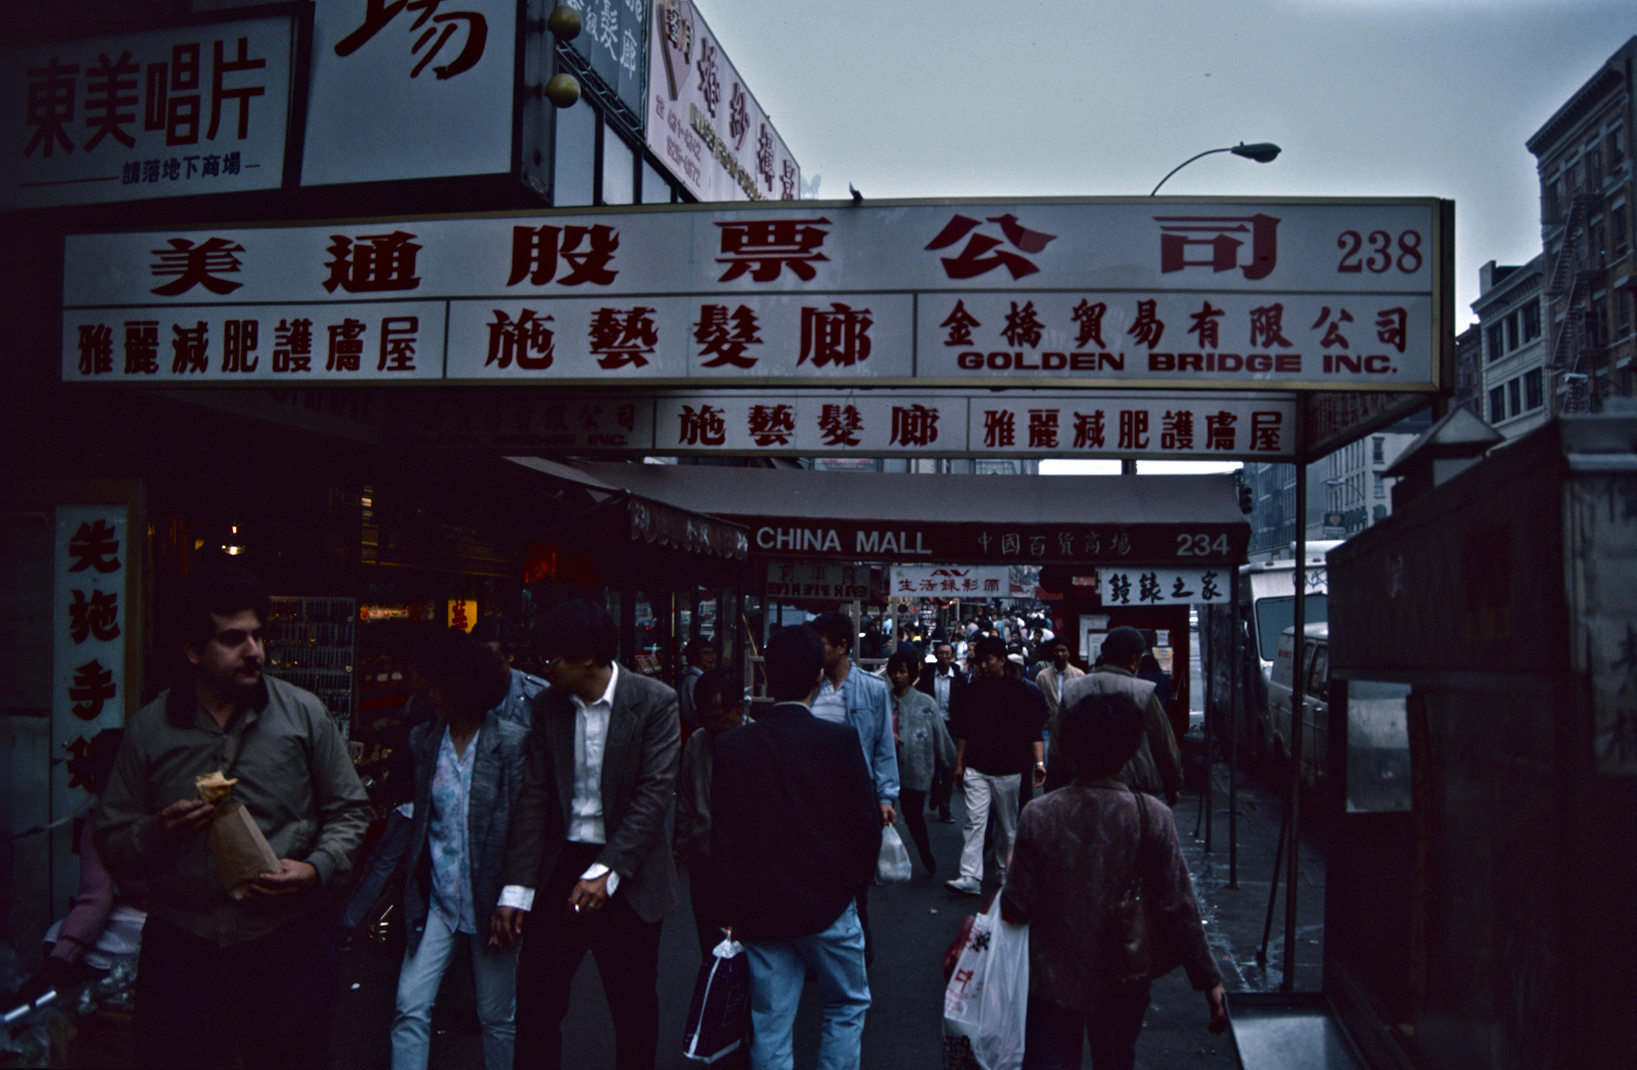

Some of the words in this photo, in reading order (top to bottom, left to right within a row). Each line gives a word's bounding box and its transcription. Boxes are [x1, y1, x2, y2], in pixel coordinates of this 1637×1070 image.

[22, 38, 267, 158] 東美唱片
[122, 152, 243, 186] 請落地下商場
[150, 214, 1282, 298] 美通股票公司
[1337, 230, 1424, 274] 238
[78, 316, 419, 375] 雅麗減肥護膚屋
[484, 302, 874, 370] 施藝髮廊
[940, 299, 1409, 353] 金橋貿易有限公司
[958, 352, 1125, 371] GOLDEN
[1148, 353, 1302, 373] BRIDGE
[1322, 354, 1398, 374] INC.
[678, 404, 940, 447] 施藝髮廊
[984, 409, 1283, 452] 雅麗減肥護膚屋
[755, 526, 843, 552] CHINA
[855, 530, 933, 555] MALL
[976, 530, 1133, 557] 中國百貨商場
[1175, 533, 1231, 557] 234
[1108, 571, 1223, 605] 鐘錶之家
